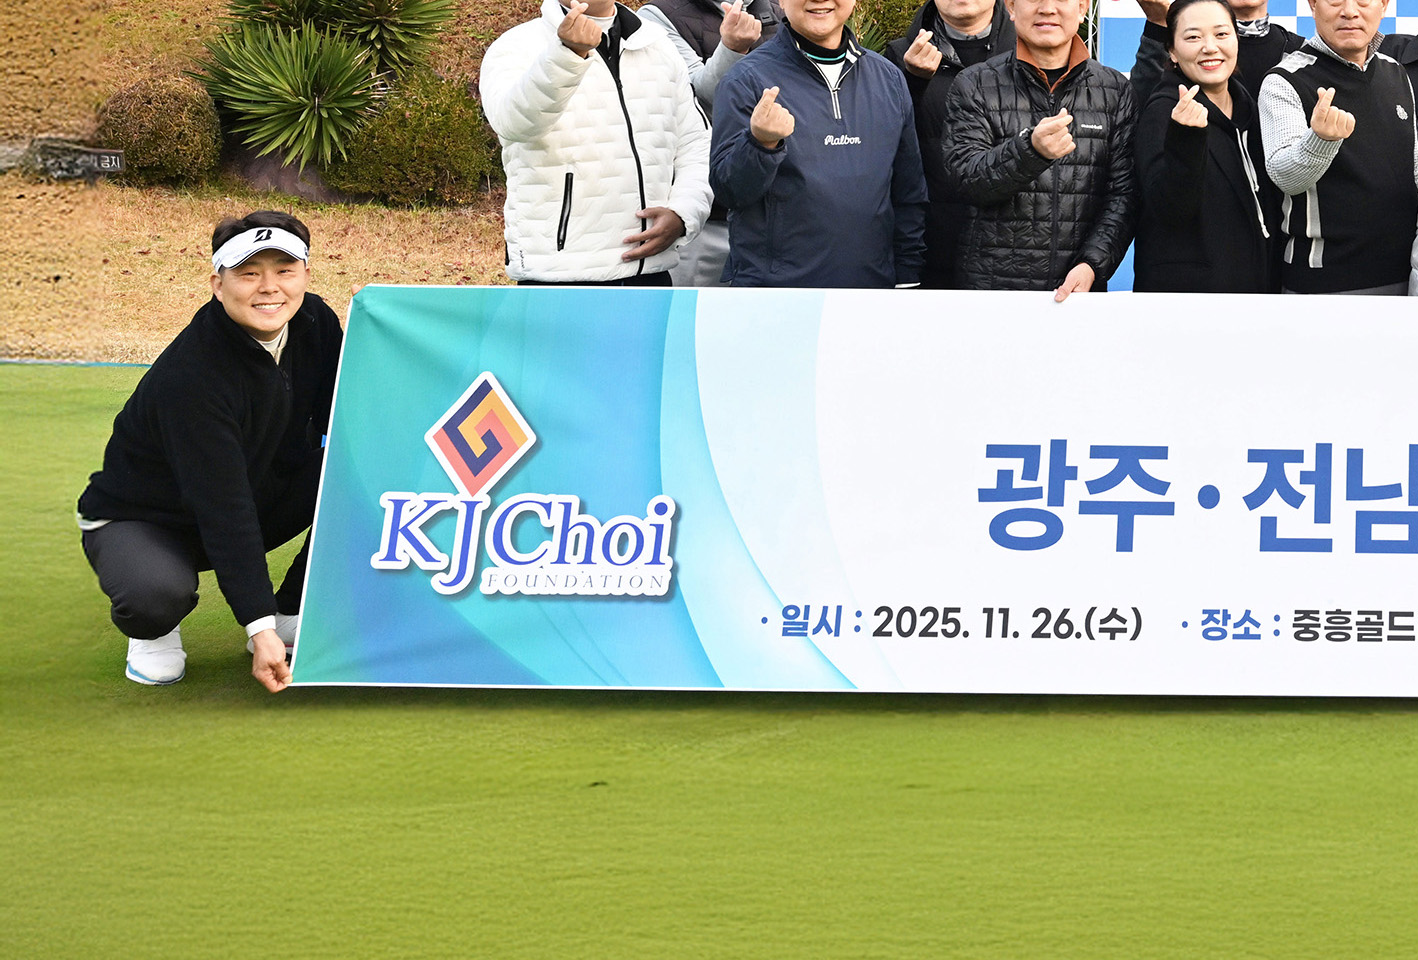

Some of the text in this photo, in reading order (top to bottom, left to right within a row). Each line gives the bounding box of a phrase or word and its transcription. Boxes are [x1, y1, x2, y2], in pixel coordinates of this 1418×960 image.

[101, 155, 120, 169] 금지
[487, 572, 664, 589] FOUNDATION
[872, 605, 970, 639] 2025.
[982, 607, 1020, 639] 11.
